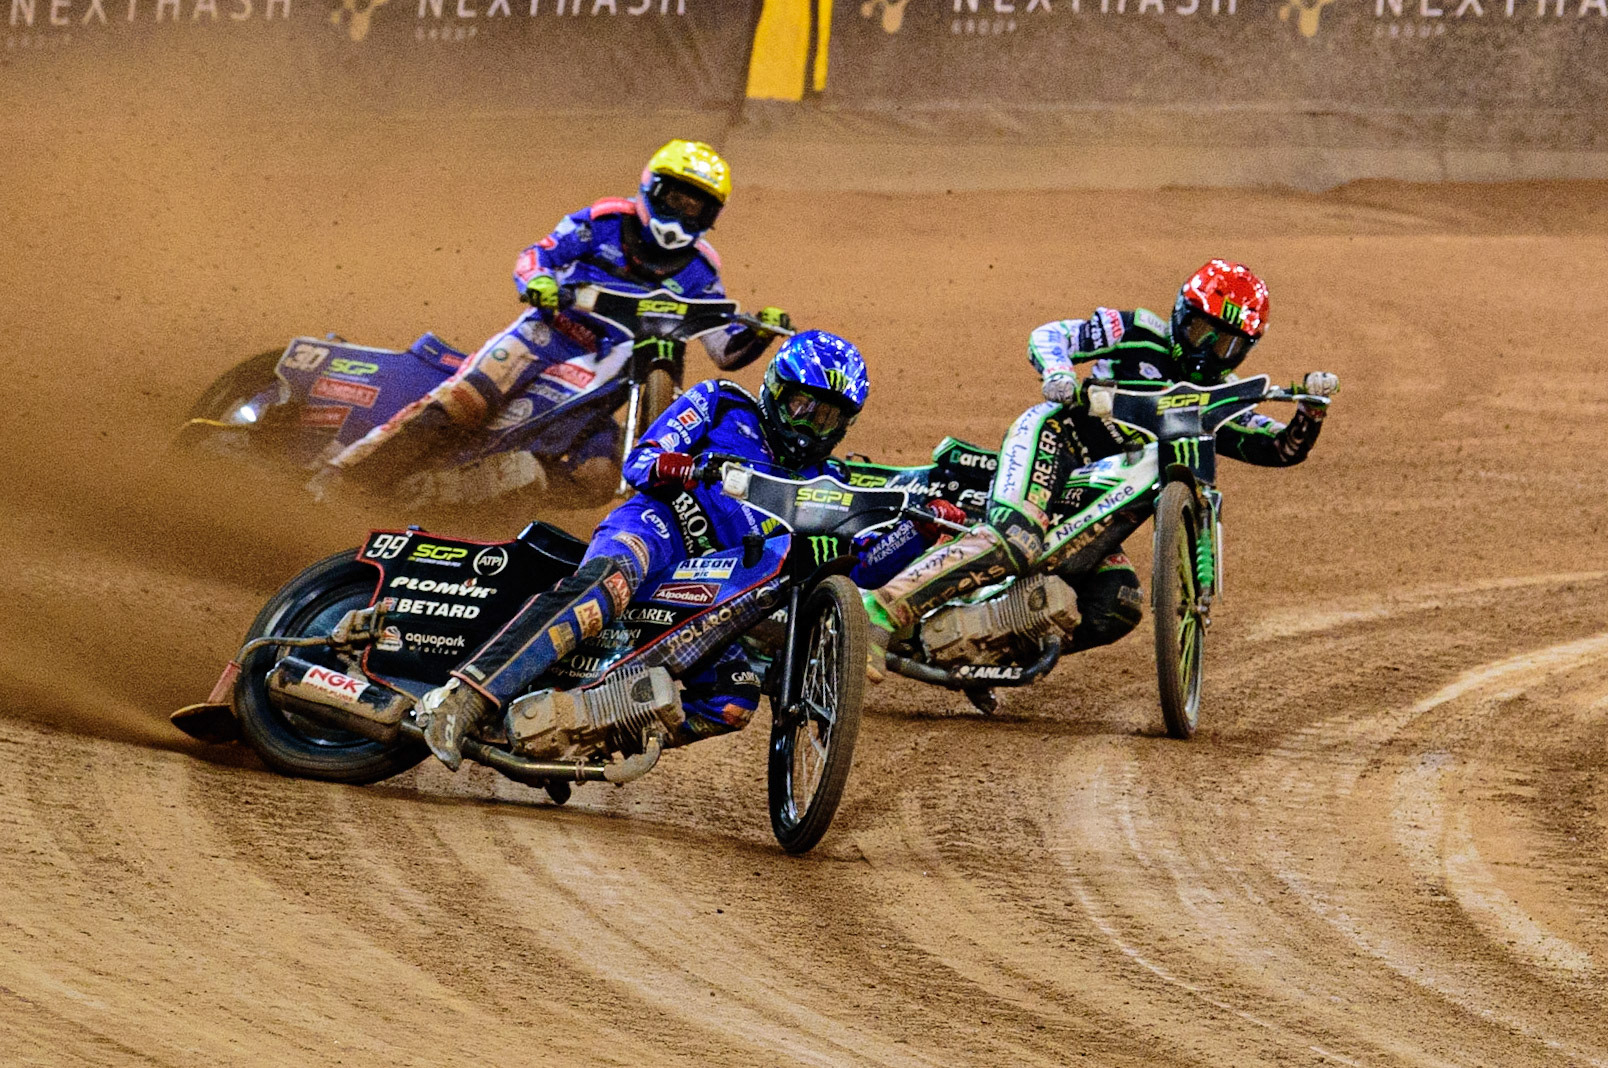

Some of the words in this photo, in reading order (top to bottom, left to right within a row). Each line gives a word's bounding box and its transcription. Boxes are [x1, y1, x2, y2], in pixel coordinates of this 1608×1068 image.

[1157, 393, 1200, 410] SGP
[1032, 430, 1057, 487] REXER
[796, 488, 843, 504] SGP
[1097, 484, 1136, 514] Nice
[1055, 513, 1093, 541] Nice
[366, 534, 409, 560] 99
[413, 544, 468, 560] SGP
[657, 591, 708, 602] Alpodach
[397, 598, 480, 619] BETARD
[405, 633, 465, 647] aquapark
[309, 668, 364, 693] NGK
[974, 666, 1023, 679] ANLAS
